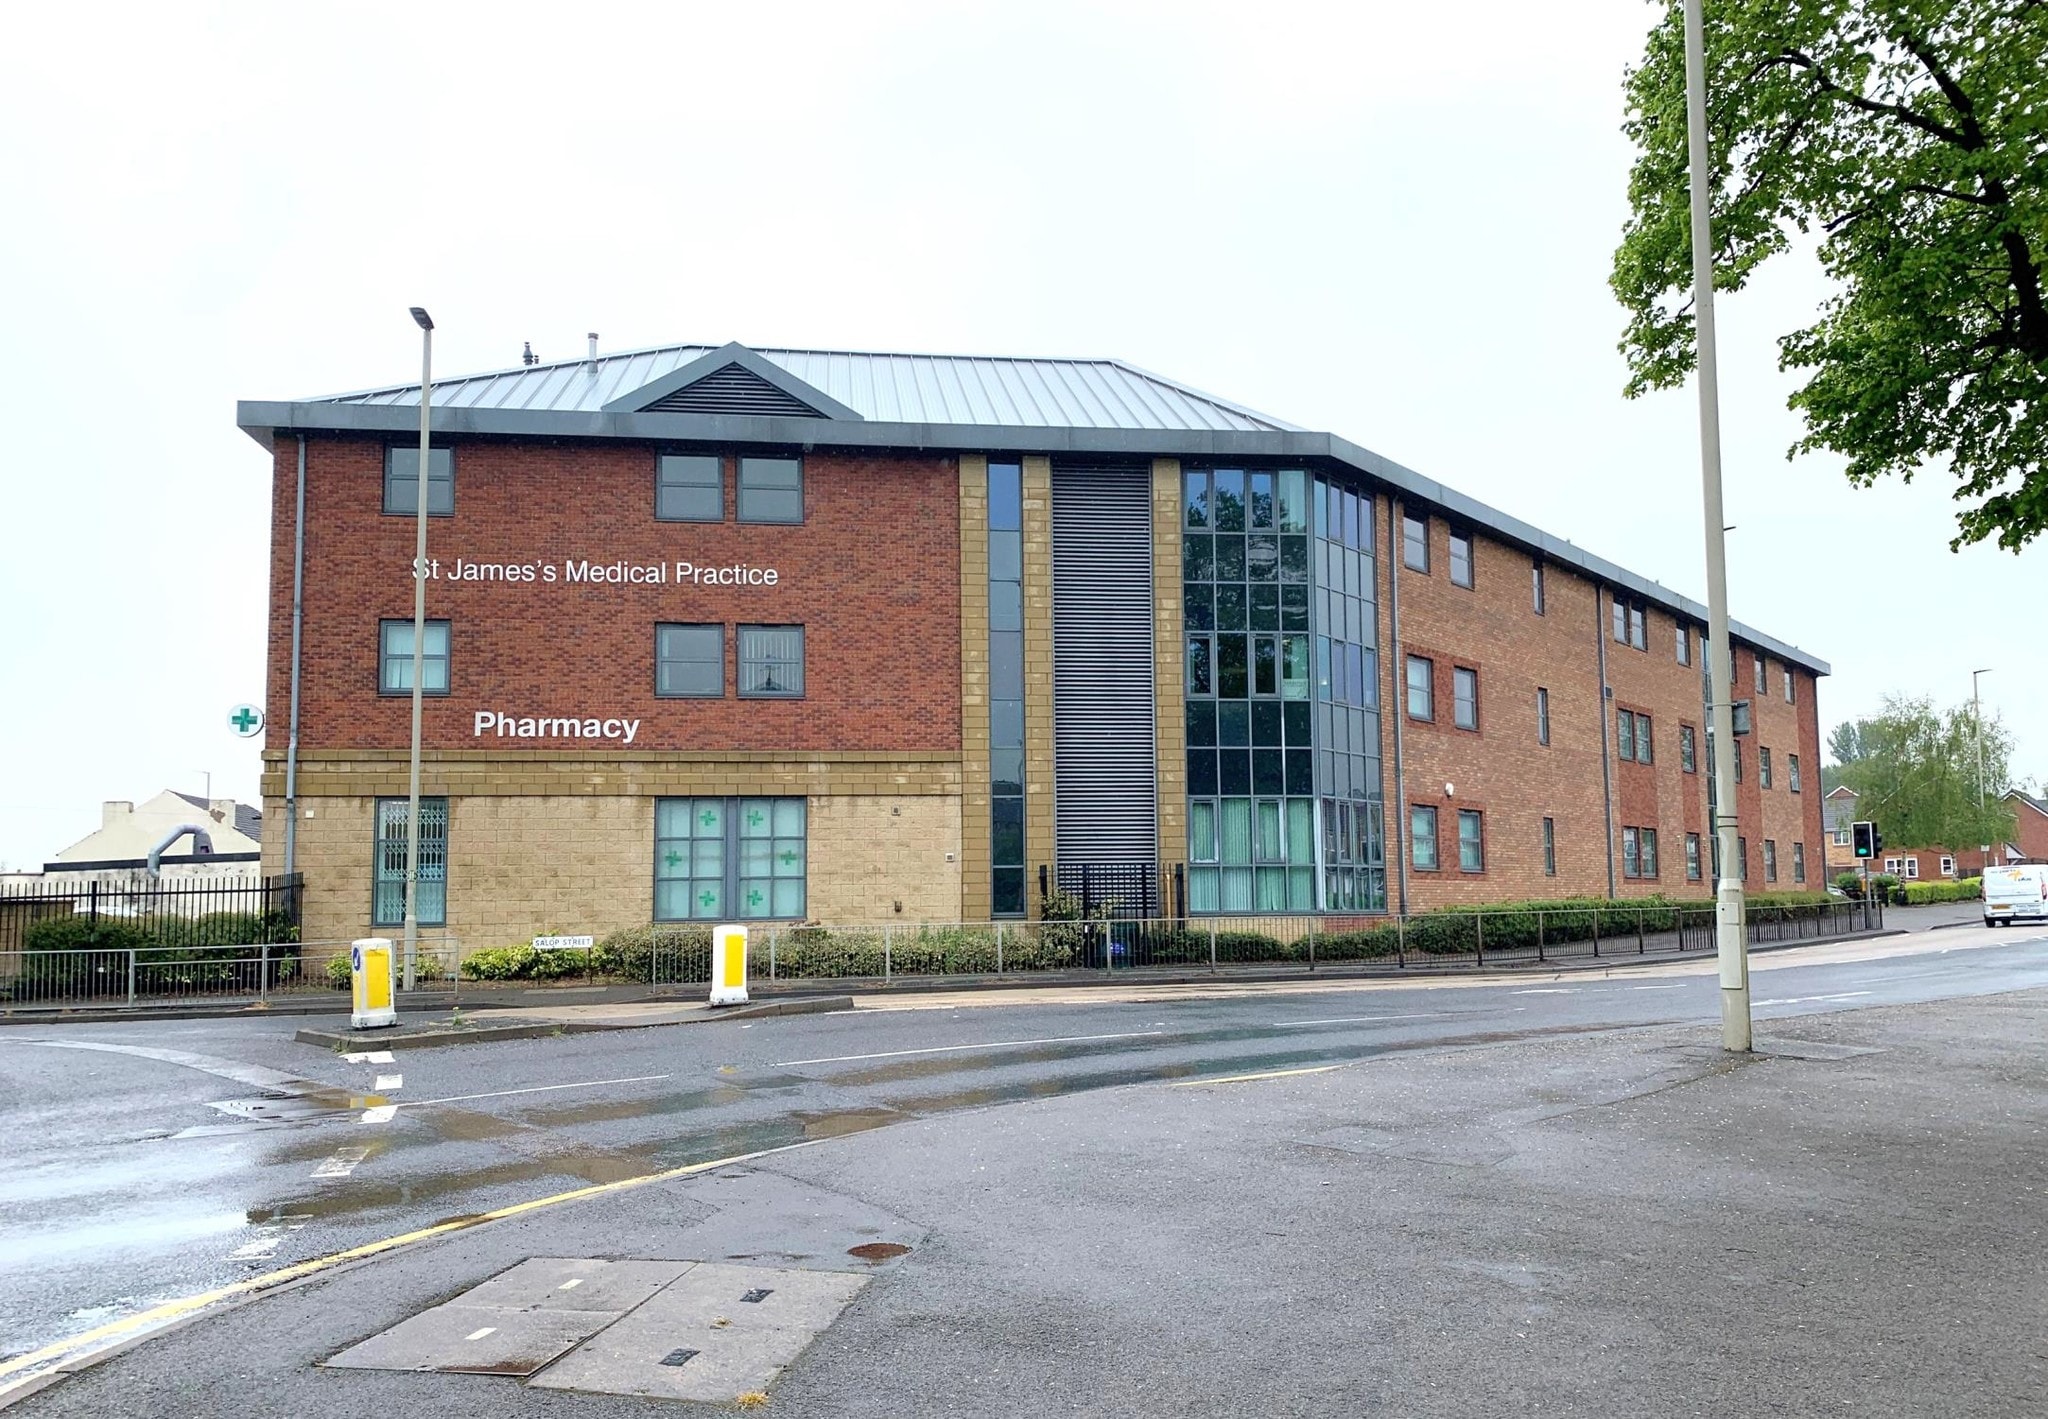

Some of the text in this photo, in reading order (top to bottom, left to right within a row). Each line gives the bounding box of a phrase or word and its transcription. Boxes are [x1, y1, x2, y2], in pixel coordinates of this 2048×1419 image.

[447, 558, 557, 582] James's
[565, 560, 666, 584] Medical
[676, 562, 778, 586] Practice
[474, 711, 641, 744] Pharmacy
[535, 938, 591, 947] SALOP STREET
